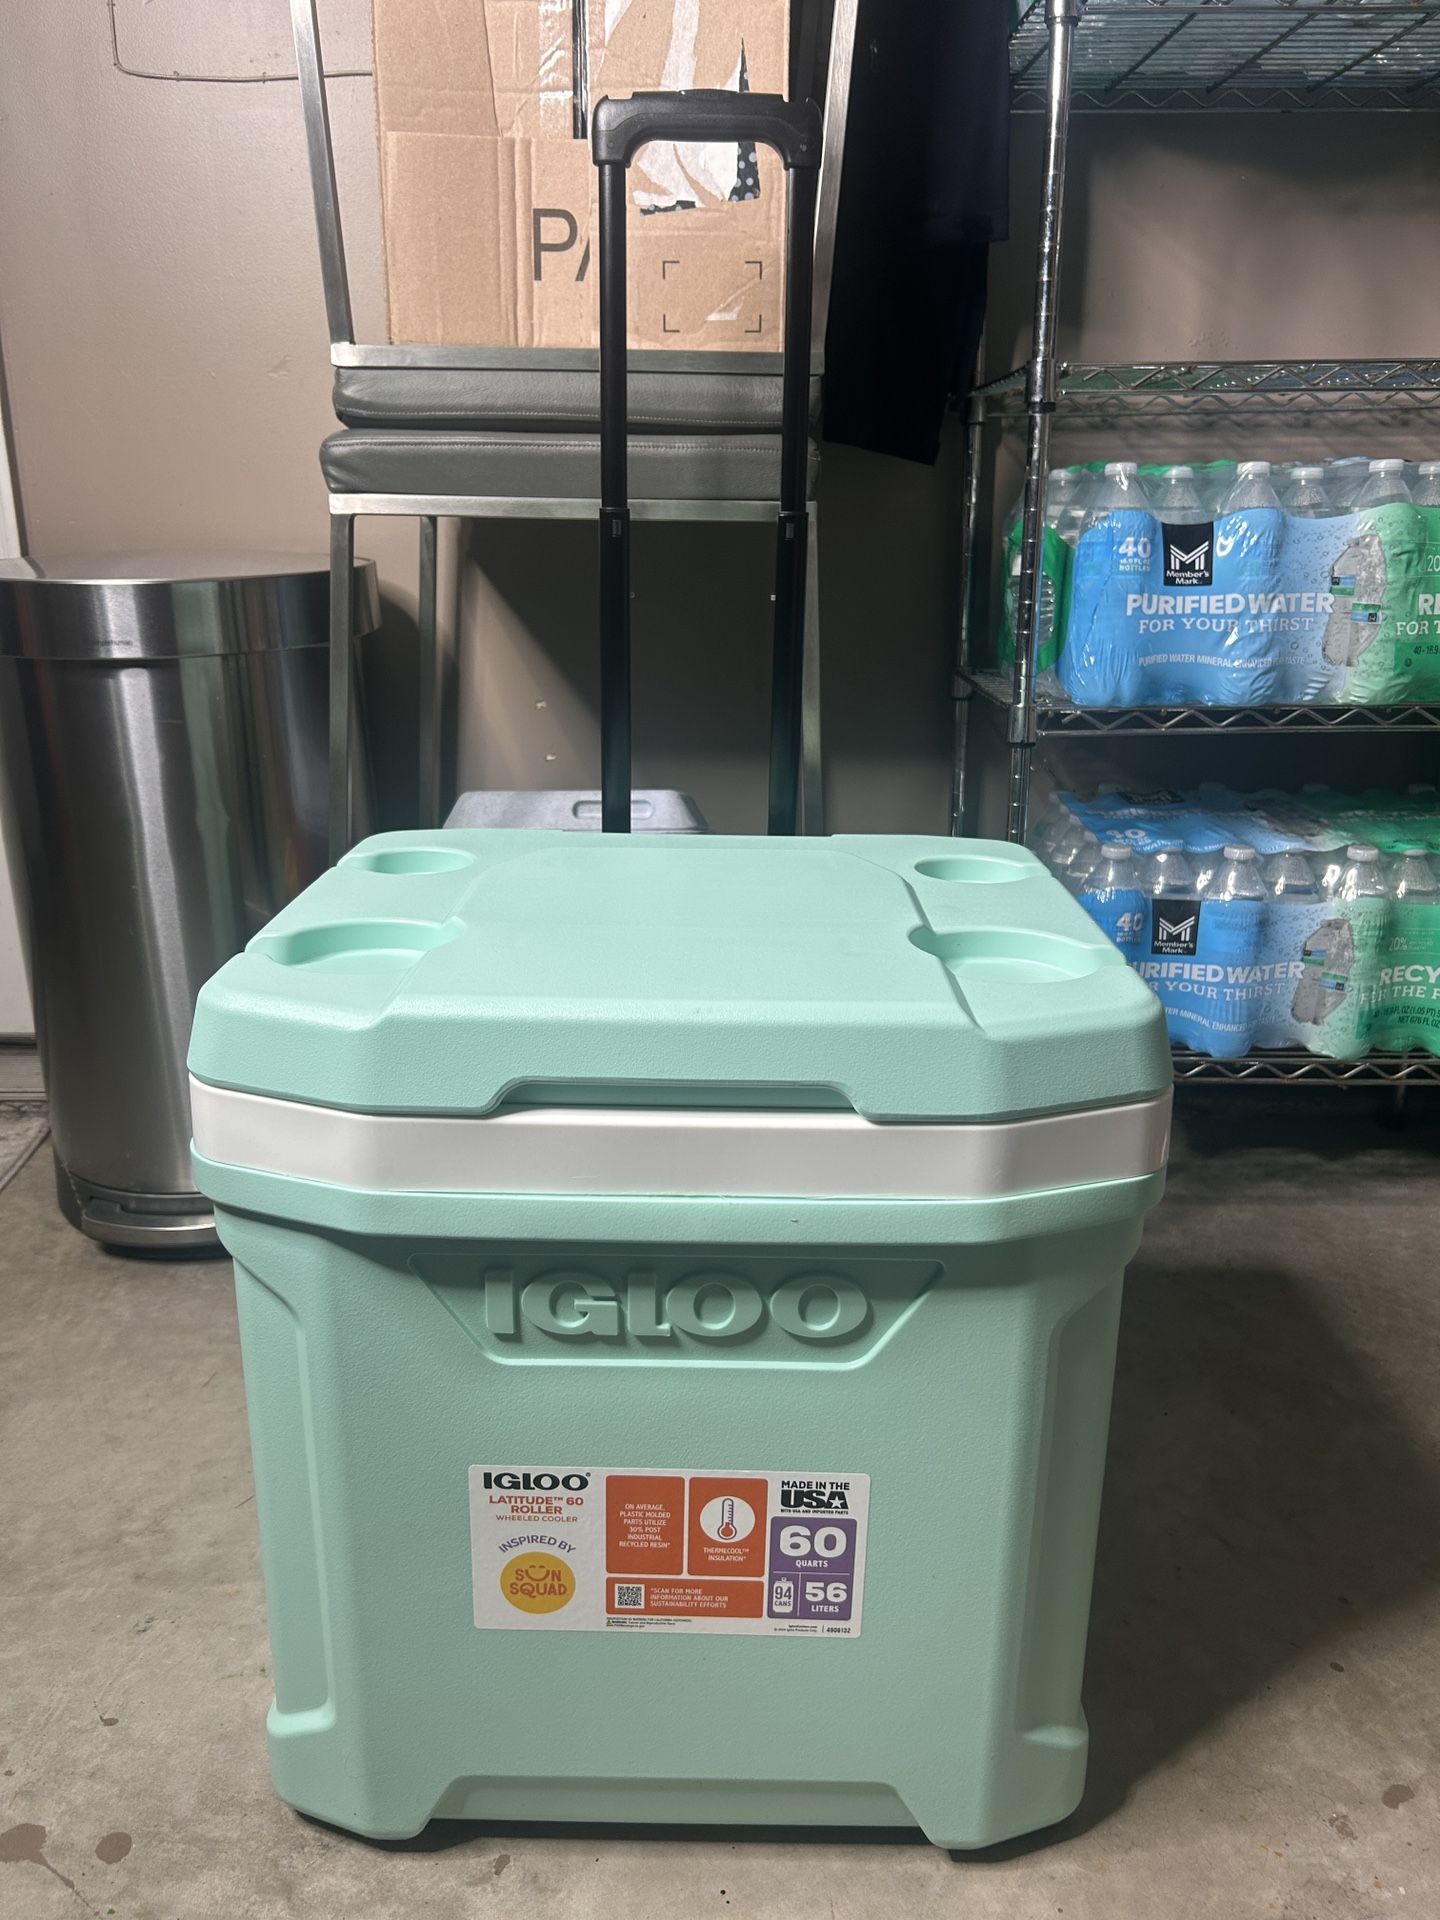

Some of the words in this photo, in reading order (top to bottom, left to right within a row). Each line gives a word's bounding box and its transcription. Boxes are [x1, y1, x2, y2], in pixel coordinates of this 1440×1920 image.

[1118, 536, 1151, 558] 40
[1166, 570, 1210, 578] Member's
[1175, 577, 1198, 585] Mark
[1126, 592, 1246, 616] PURIFIED
[1245, 592, 1335, 614] WATER
[1138, 618, 1175, 634] FOR
[1181, 617, 1239, 633] YOUR
[1244, 617, 1314, 634] THIRST
[1396, 620, 1429, 635] FOR
[1138, 654, 1168, 667] PURIFIED
[1169, 653, 1196, 664] WATER
[1196, 655, 1233, 668] MINERAL
[1116, 912, 1144, 931] 40
[1154, 940, 1194, 948] Member's
[1389, 937, 1408, 951] 20%
[1226, 961, 1306, 984] WATER
[1164, 981, 1218, 1000] YOUR
[1223, 982, 1286, 1001] THIRST
[1392, 985, 1427, 998] THE
[1179, 1009, 1211, 1028] MINERAL
[485, 1268, 868, 1338] IGLOO
[781, 1480, 813, 1489] MADE
[816, 1481, 827, 1490] IN
[829, 1482, 850, 1490] THE
[566, 1497, 584, 1506] 60
[780, 1489, 849, 1509] USA
[511, 1505, 563, 1514] ROLLER
[495, 1514, 540, 1522] WHEELED
[498, 1535, 557, 1553] INSPIRED
[557, 1540, 577, 1553] BY
[627, 1533, 662, 1541] INDUSTRIAL
[780, 1525, 847, 1558] 60
[795, 1560, 829, 1568] QUARTS
[515, 1568, 562, 1582] SUN
[509, 1582, 567, 1598] SQUAD
[774, 1585, 792, 1600] 94
[805, 1581, 848, 1602] 56
[650, 1600, 698, 1608] SUSTAINABILITY
[811, 1604, 840, 1612] LITERS
